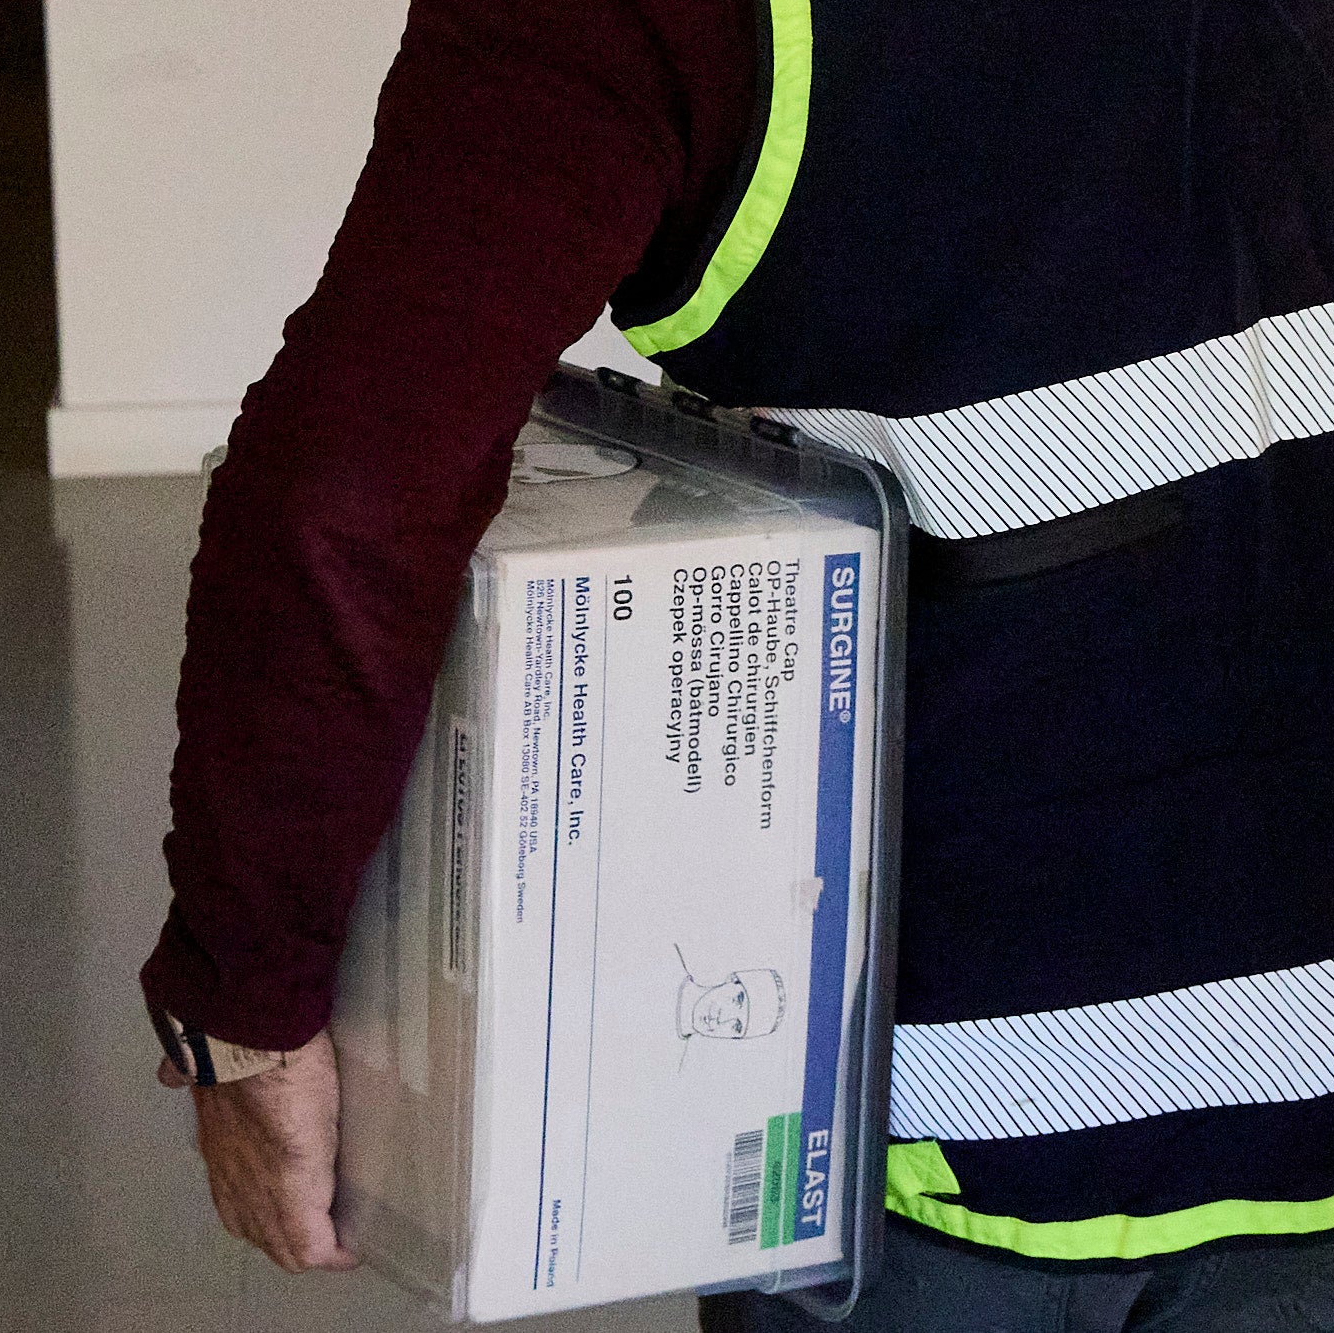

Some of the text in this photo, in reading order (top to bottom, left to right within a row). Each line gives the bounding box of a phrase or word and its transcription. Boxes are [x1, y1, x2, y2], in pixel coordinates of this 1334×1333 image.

[524, 580, 535, 635] Mölnlycke
[544, 578, 555, 634] Mölnlycke
[613, 574, 633, 621] 100
[688, 566, 706, 672] Op-mössa
[781, 558, 800, 682] Theatre Cap
[524, 636, 534, 672] Health
[544, 635, 554, 671] Health
[665, 568, 688, 765] Czepek operacyjny
[706, 565, 726, 718] Gorro Cirujano
[742, 562, 763, 756] Calot de chirurgien
[523, 674, 533, 698] Care
[722, 564, 744, 787] Cappellino Chirurgico
[760, 560, 781, 831] OP-Haube, Schiffchenform
[522, 700, 532, 716] AB
[522, 720, 532, 740] Box
[568, 576, 590, 846] Mölnlycke Health Care, Inc.
[530, 780, 540, 795] PA
[528, 830, 538, 854] USA
[516, 882, 526, 924] Sweden
[801, 1128, 829, 1227] ELAST
[549, 1234, 559, 1246] in
[551, 1199, 562, 1231] Made
